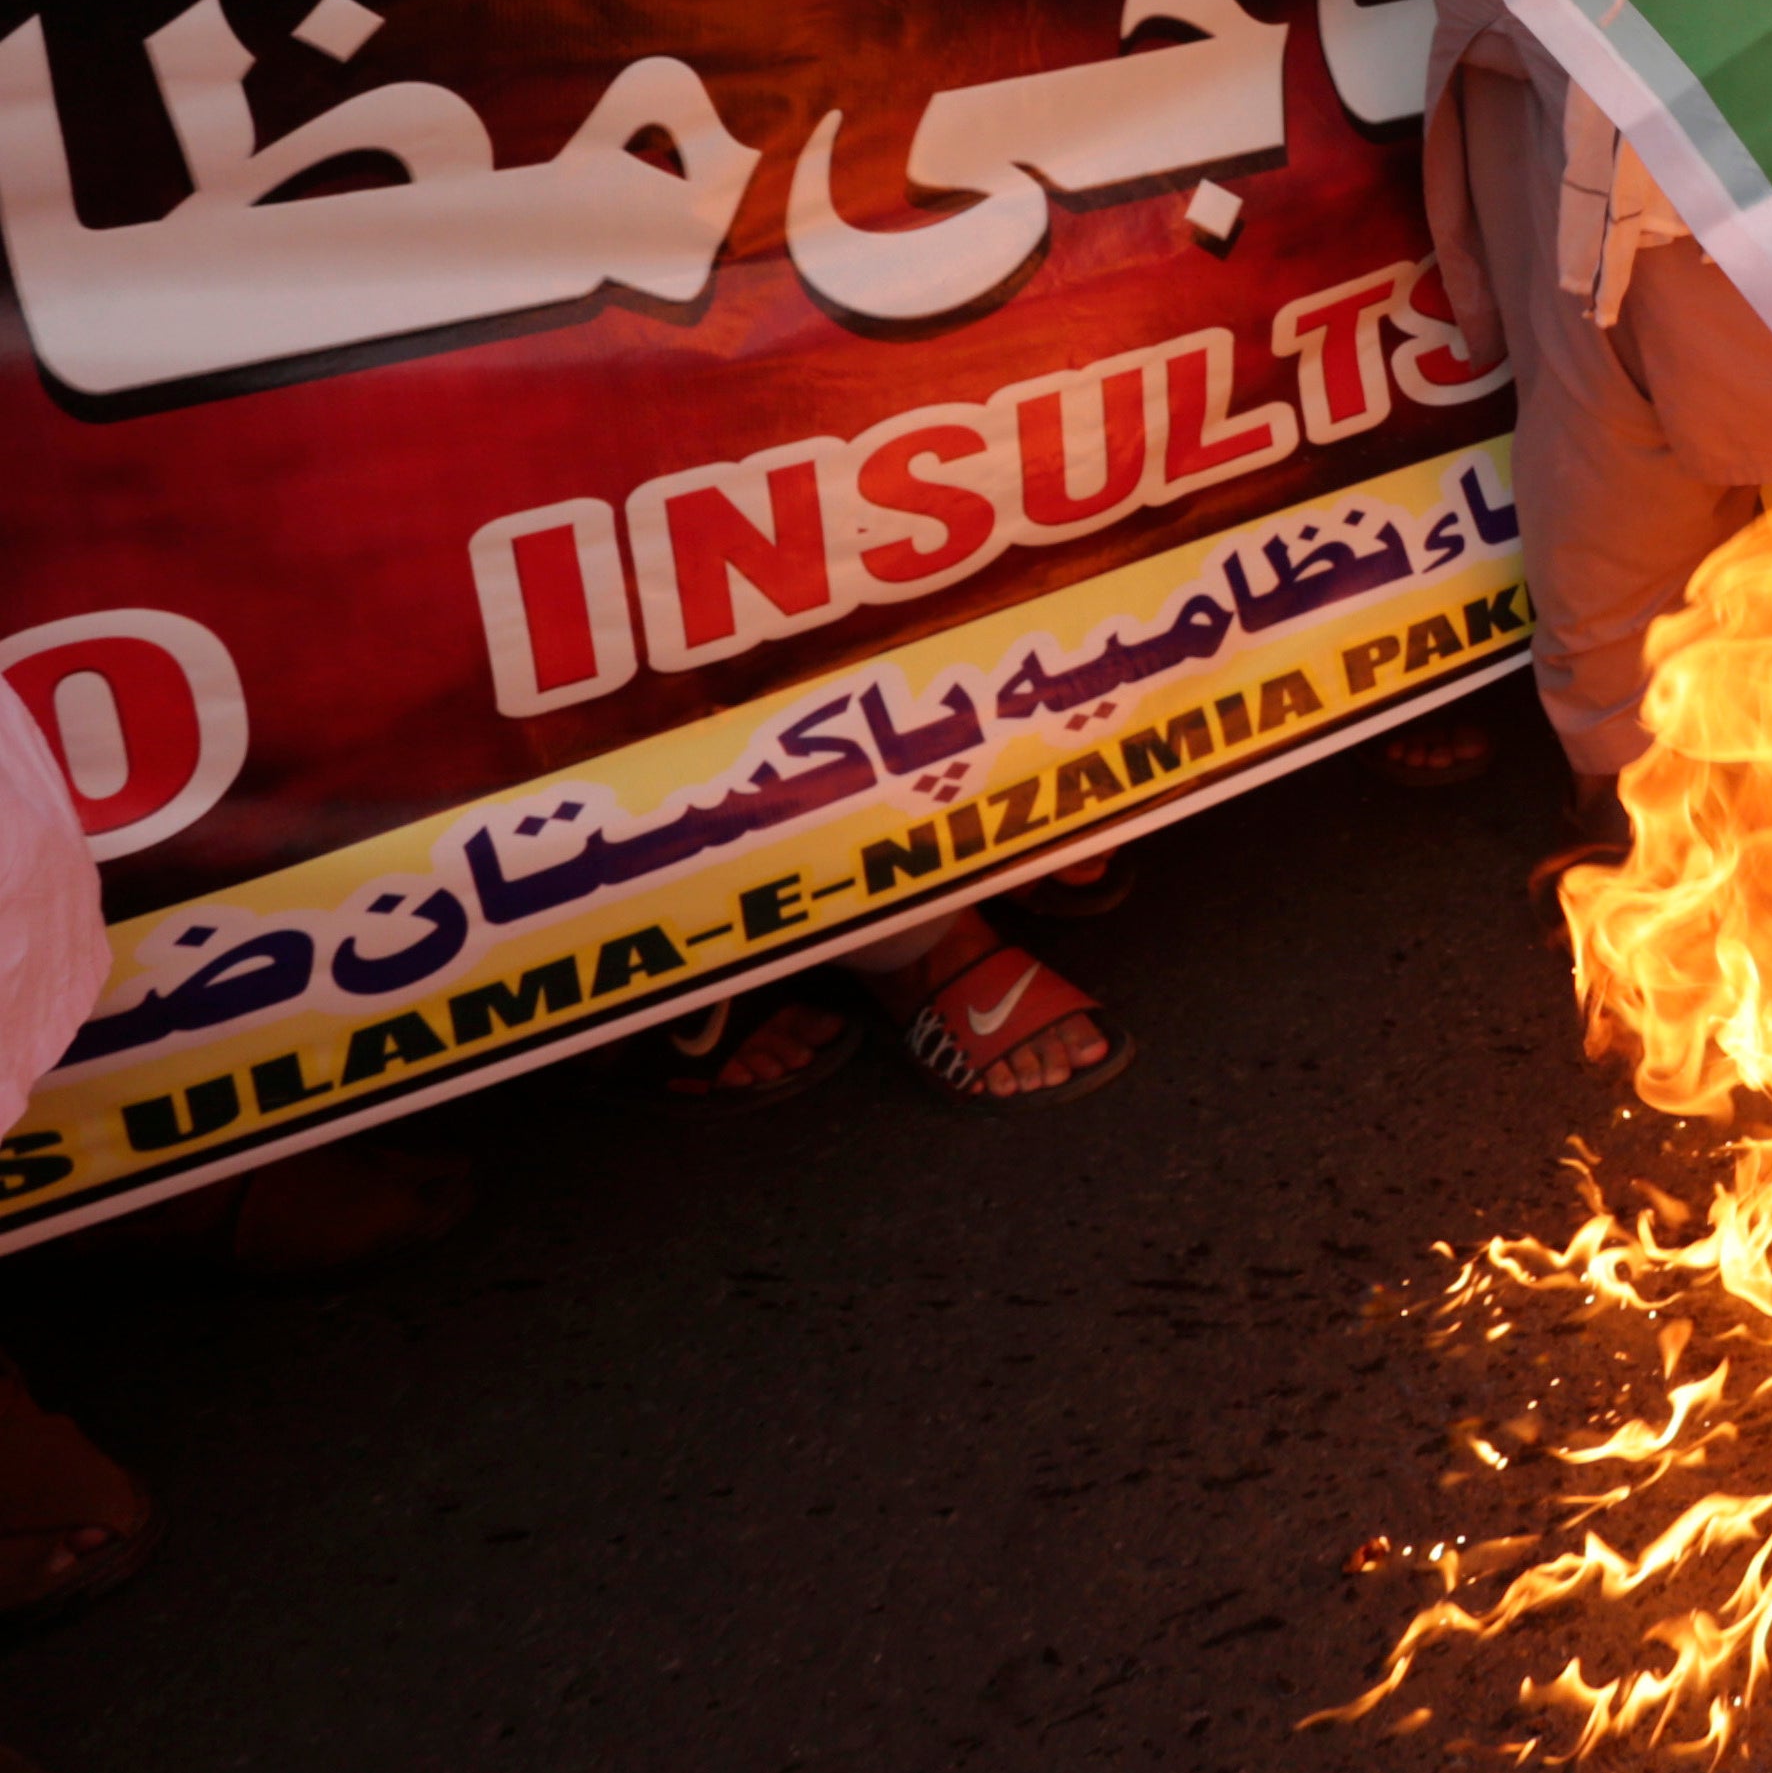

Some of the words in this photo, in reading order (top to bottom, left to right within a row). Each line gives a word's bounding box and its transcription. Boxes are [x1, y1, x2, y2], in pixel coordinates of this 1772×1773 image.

[472, 250, 1515, 718] INSULTS
[121, 668, 1323, 1153] ULAMA-E-NIZAMIA
[1341, 576, 1538, 696] PAK
[331, 680, 986, 996] پاکستان
